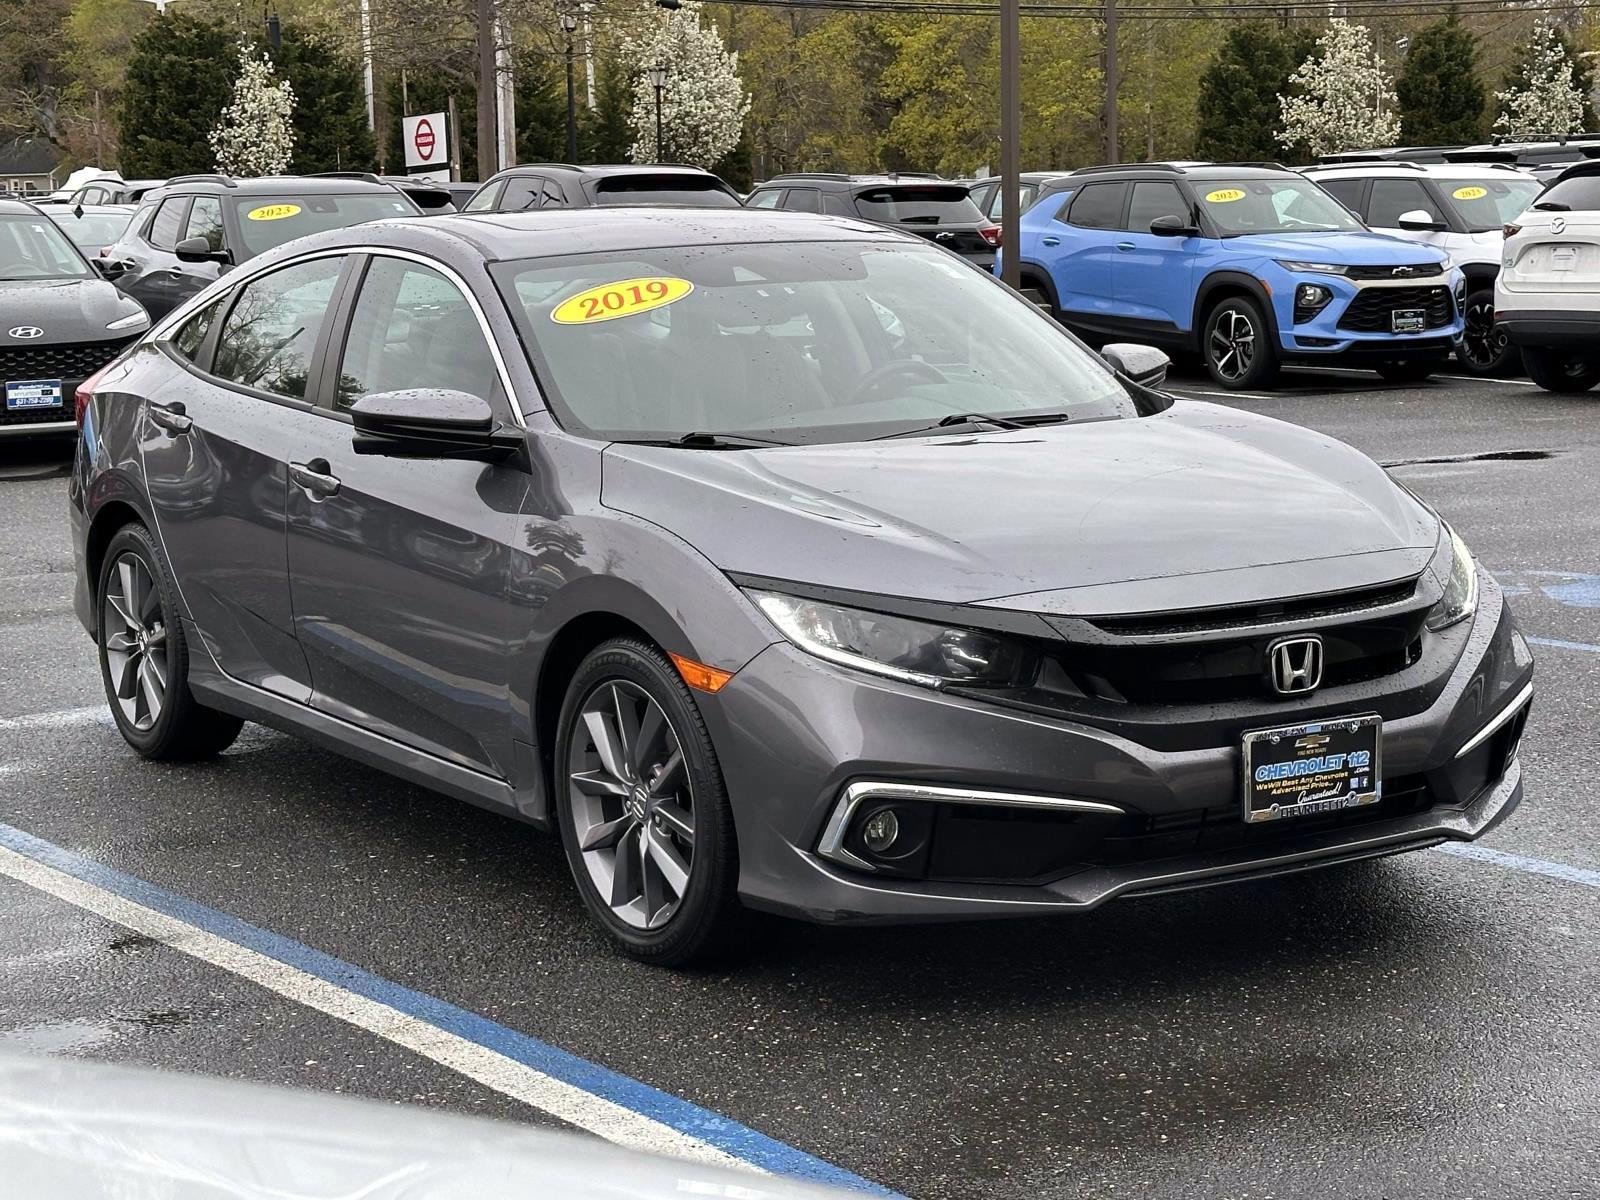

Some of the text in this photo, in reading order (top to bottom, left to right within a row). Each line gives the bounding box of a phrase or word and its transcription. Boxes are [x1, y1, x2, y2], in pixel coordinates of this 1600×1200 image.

[1214, 191, 1238, 201] 2023
[259, 206, 290, 218] 2023
[579, 281, 669, 319] 2019
[1255, 751, 1370, 781] CHEVROLET 112
[1282, 778, 1299, 787] Beat
[1300, 776, 1313, 786] Any
[1315, 771, 1348, 782] Chevrolet
[1271, 784, 1310, 795] Advertised
